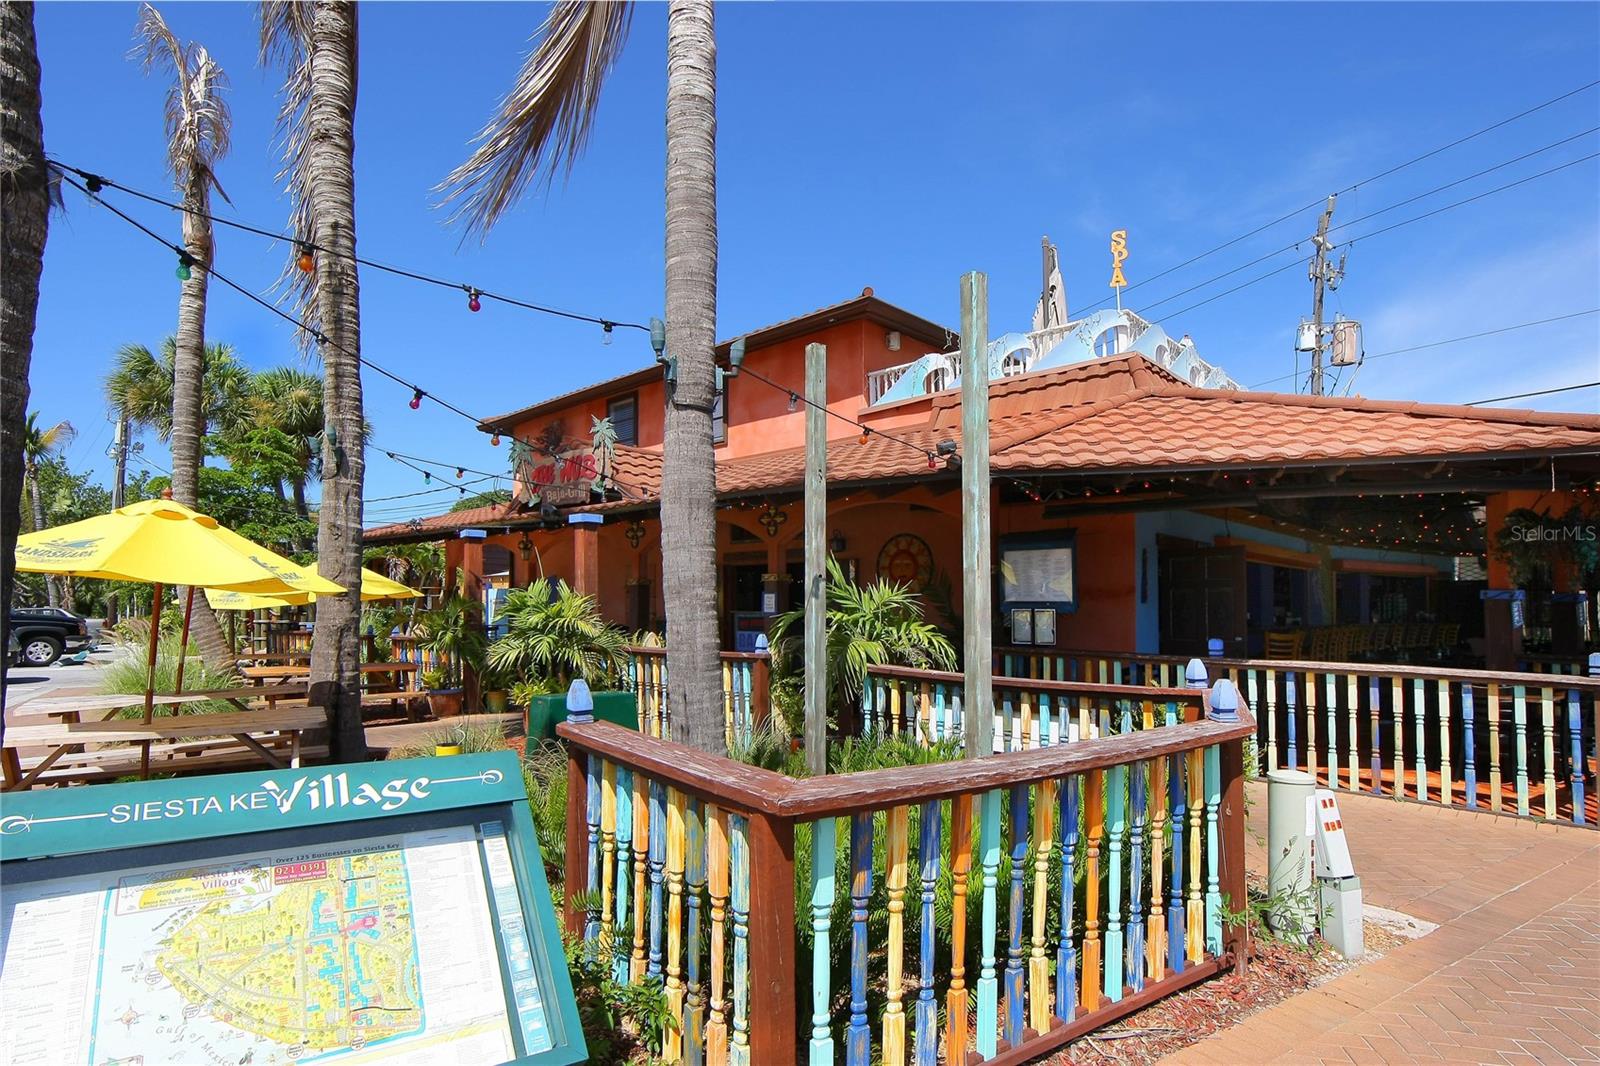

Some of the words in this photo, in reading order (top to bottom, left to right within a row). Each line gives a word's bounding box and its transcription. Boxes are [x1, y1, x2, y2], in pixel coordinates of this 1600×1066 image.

[1110, 230, 1128, 287] SPA
[560, 454, 597, 483] HUB
[110, 796, 222, 824] SIESTA
[230, 788, 288, 812] KEY
[260, 772, 430, 814] Village
[297, 853, 309, 861] 125
[311, 849, 351, 859] Businesses
[276, 865, 295, 876] 921
[300, 861, 326, 873] 0391
[201, 877, 245, 890] Village
